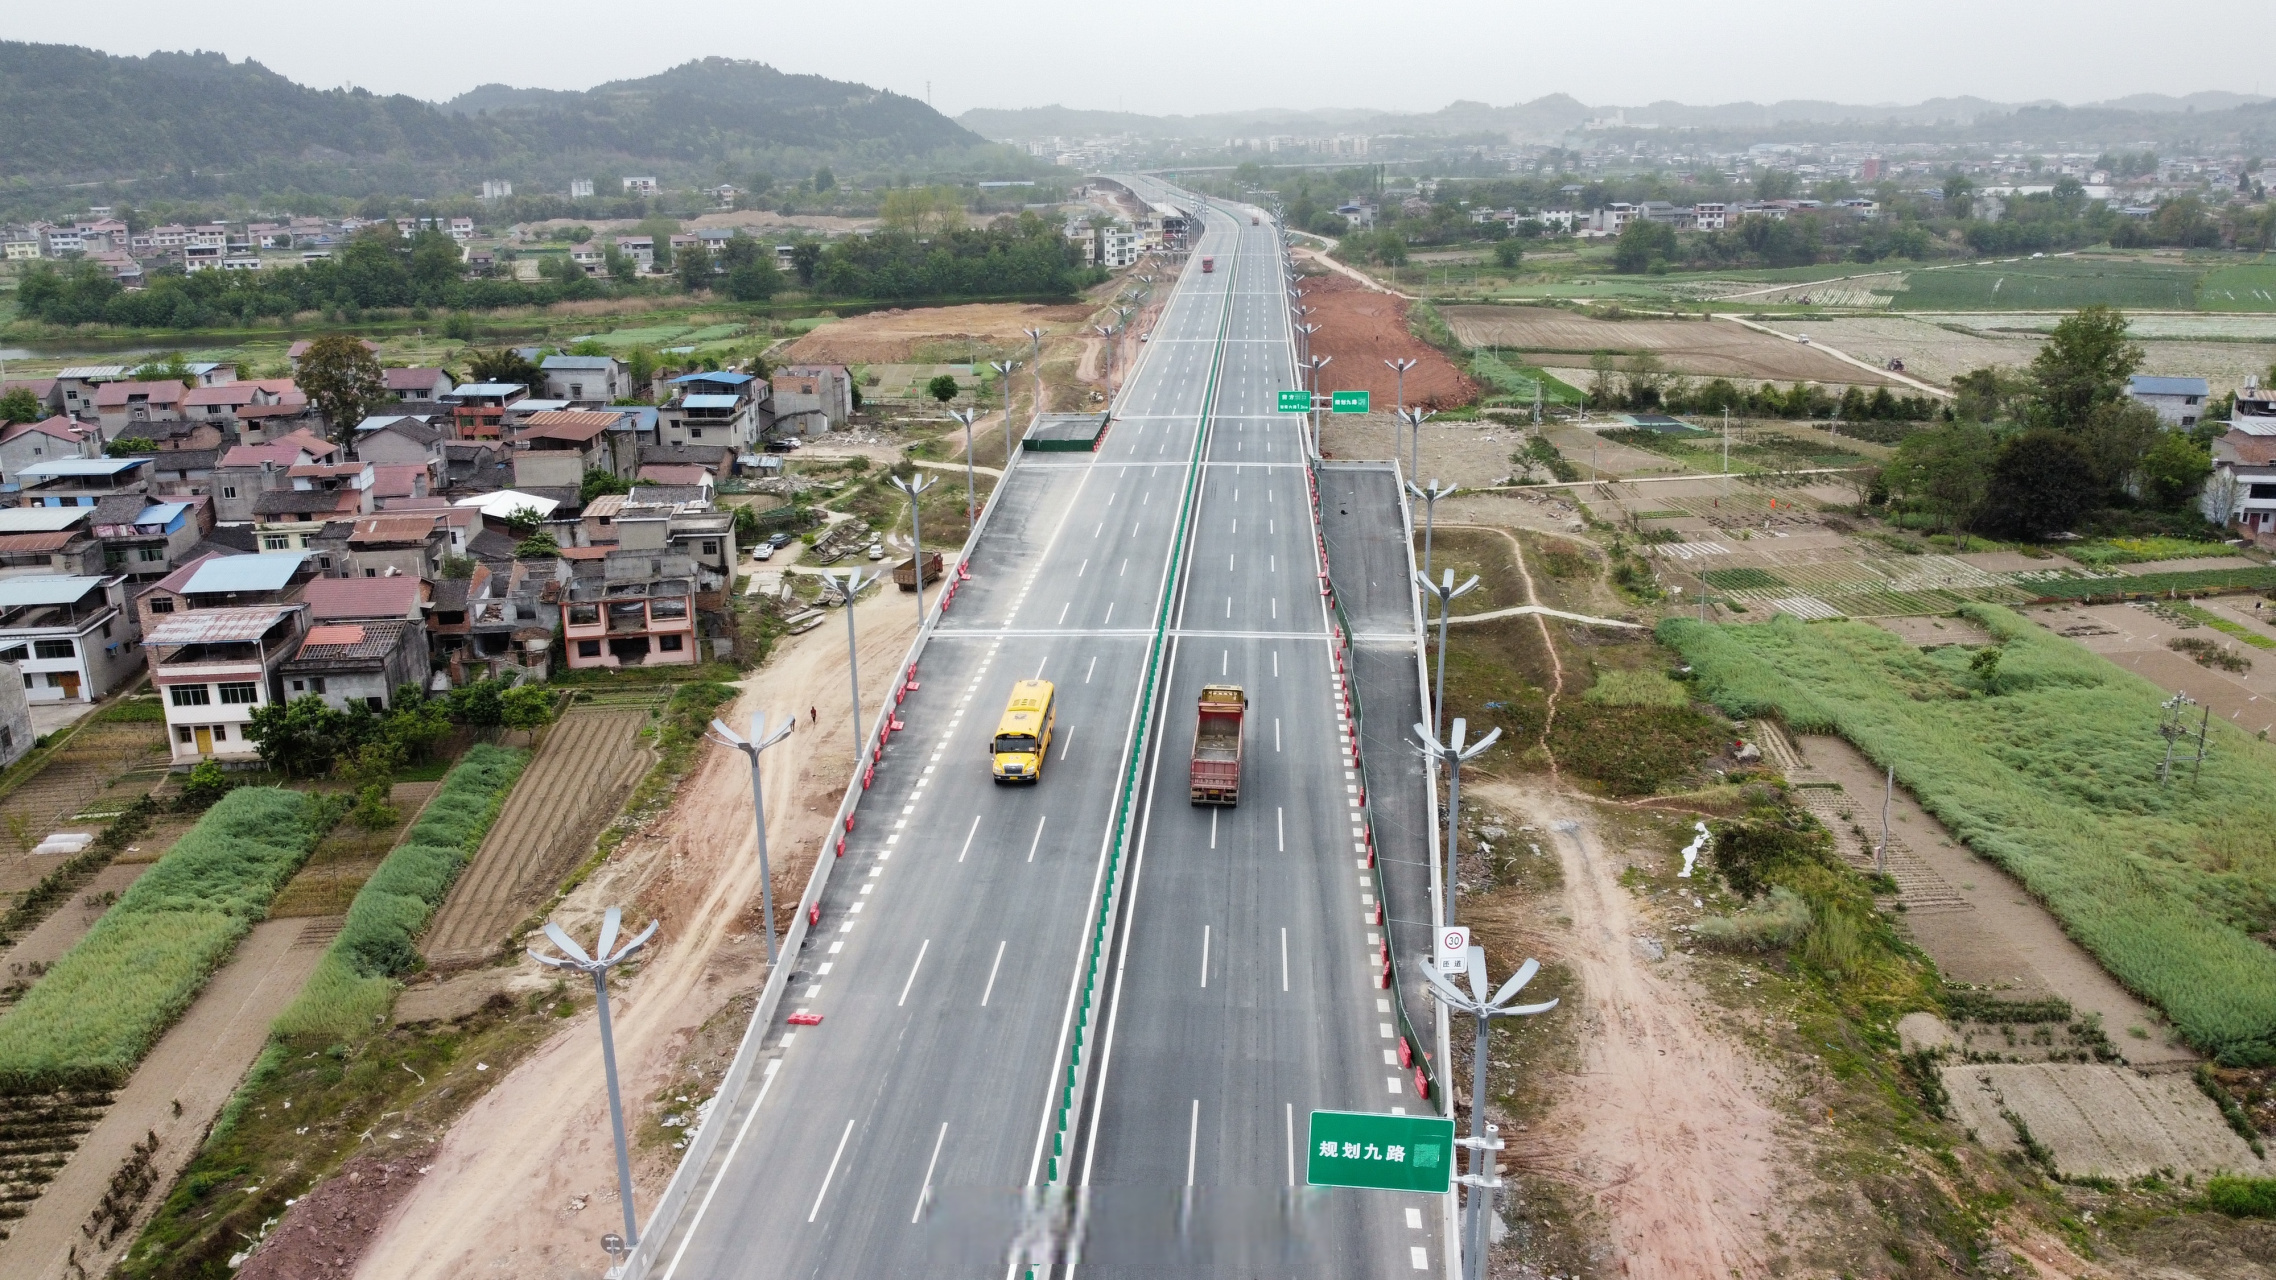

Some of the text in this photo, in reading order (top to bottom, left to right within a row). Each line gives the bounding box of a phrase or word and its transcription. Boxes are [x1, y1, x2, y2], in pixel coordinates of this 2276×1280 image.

[1449, 936, 1460, 945] 30
[1319, 1140, 1406, 1163] 规划九路
